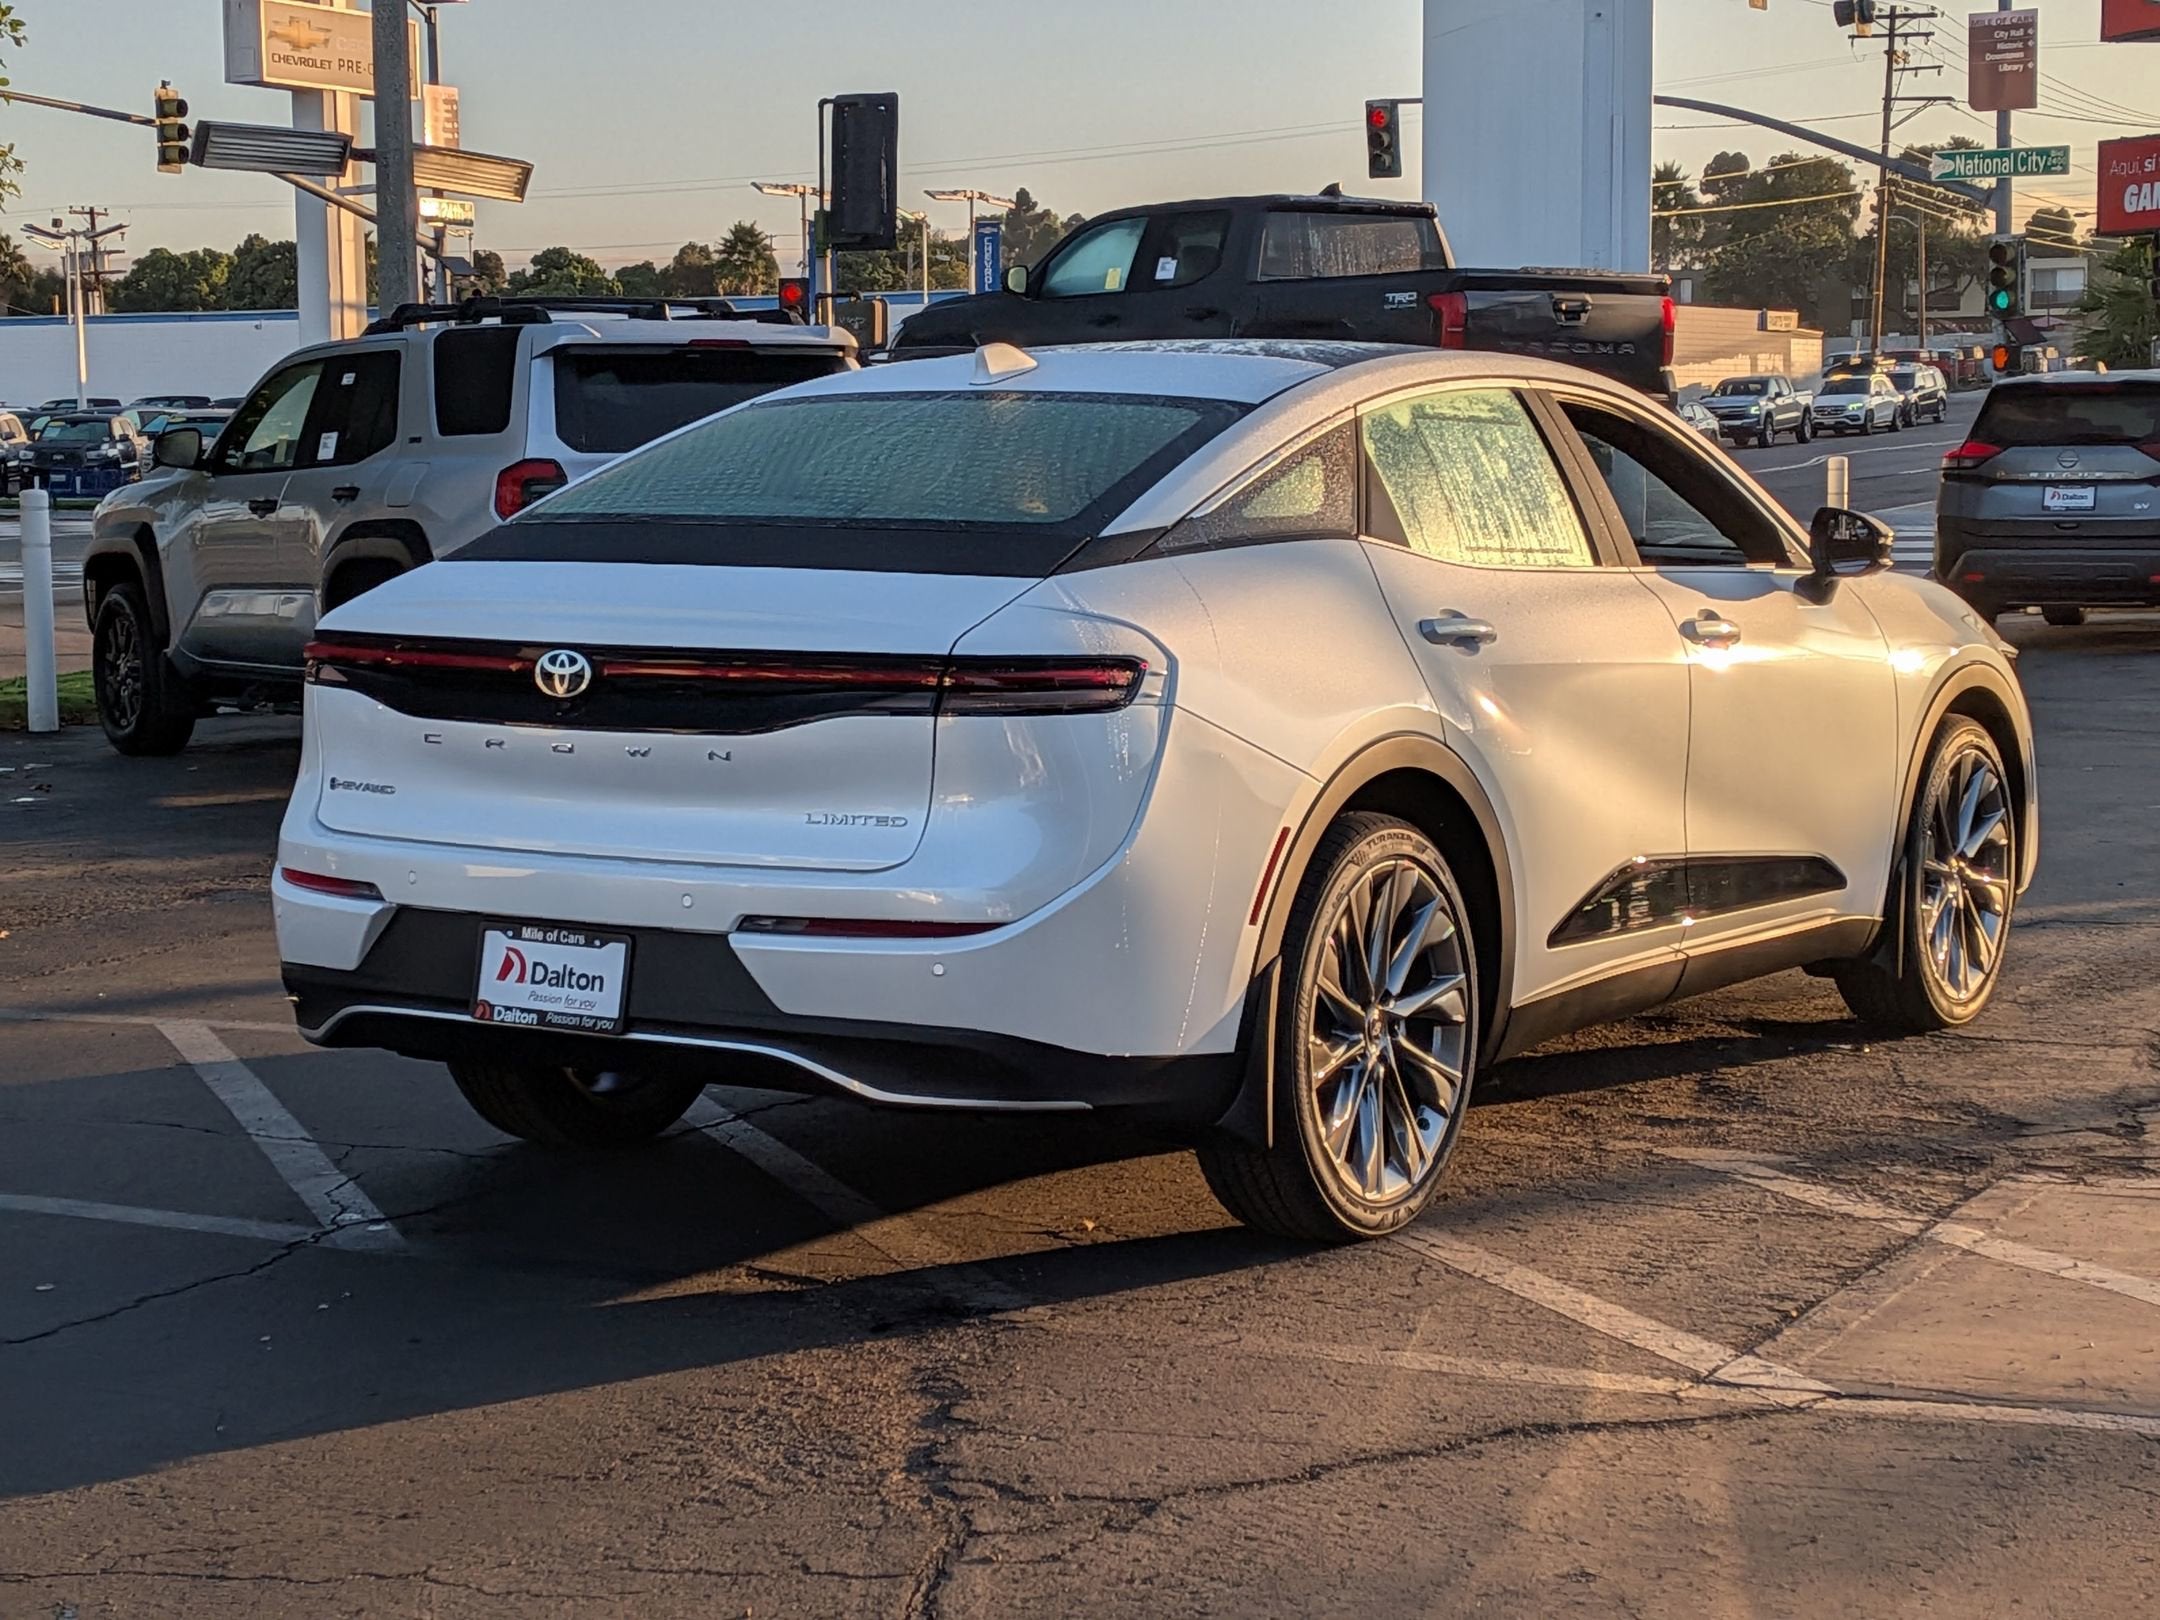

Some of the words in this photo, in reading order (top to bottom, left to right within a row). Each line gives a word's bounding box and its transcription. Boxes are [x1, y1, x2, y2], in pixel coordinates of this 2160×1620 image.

[1994, 30, 2008, 40] City
[271, 52, 333, 70] CHEVROLET
[1998, 63, 2024, 73] Library
[1954, 152, 2014, 176] National
[2017, 151, 2046, 173] City
[423, 732, 732, 762] CROWN
[804, 812, 909, 827] LIMITED
[1366, 832, 1414, 849] TURANZA
[521, 926, 544, 940] Mile
[545, 930, 558, 942] of
[560, 931, 586, 945] Cars
[530, 961, 605, 993] Dalton
[528, 990, 562, 1005] Passion
[563, 992, 579, 1007] for
[578, 997, 597, 1010] you
[493, 1006, 539, 1026] Dalton
[545, 1011, 580, 1026] Passion
[580, 1015, 596, 1029] for
[595, 1018, 616, 1031] you
